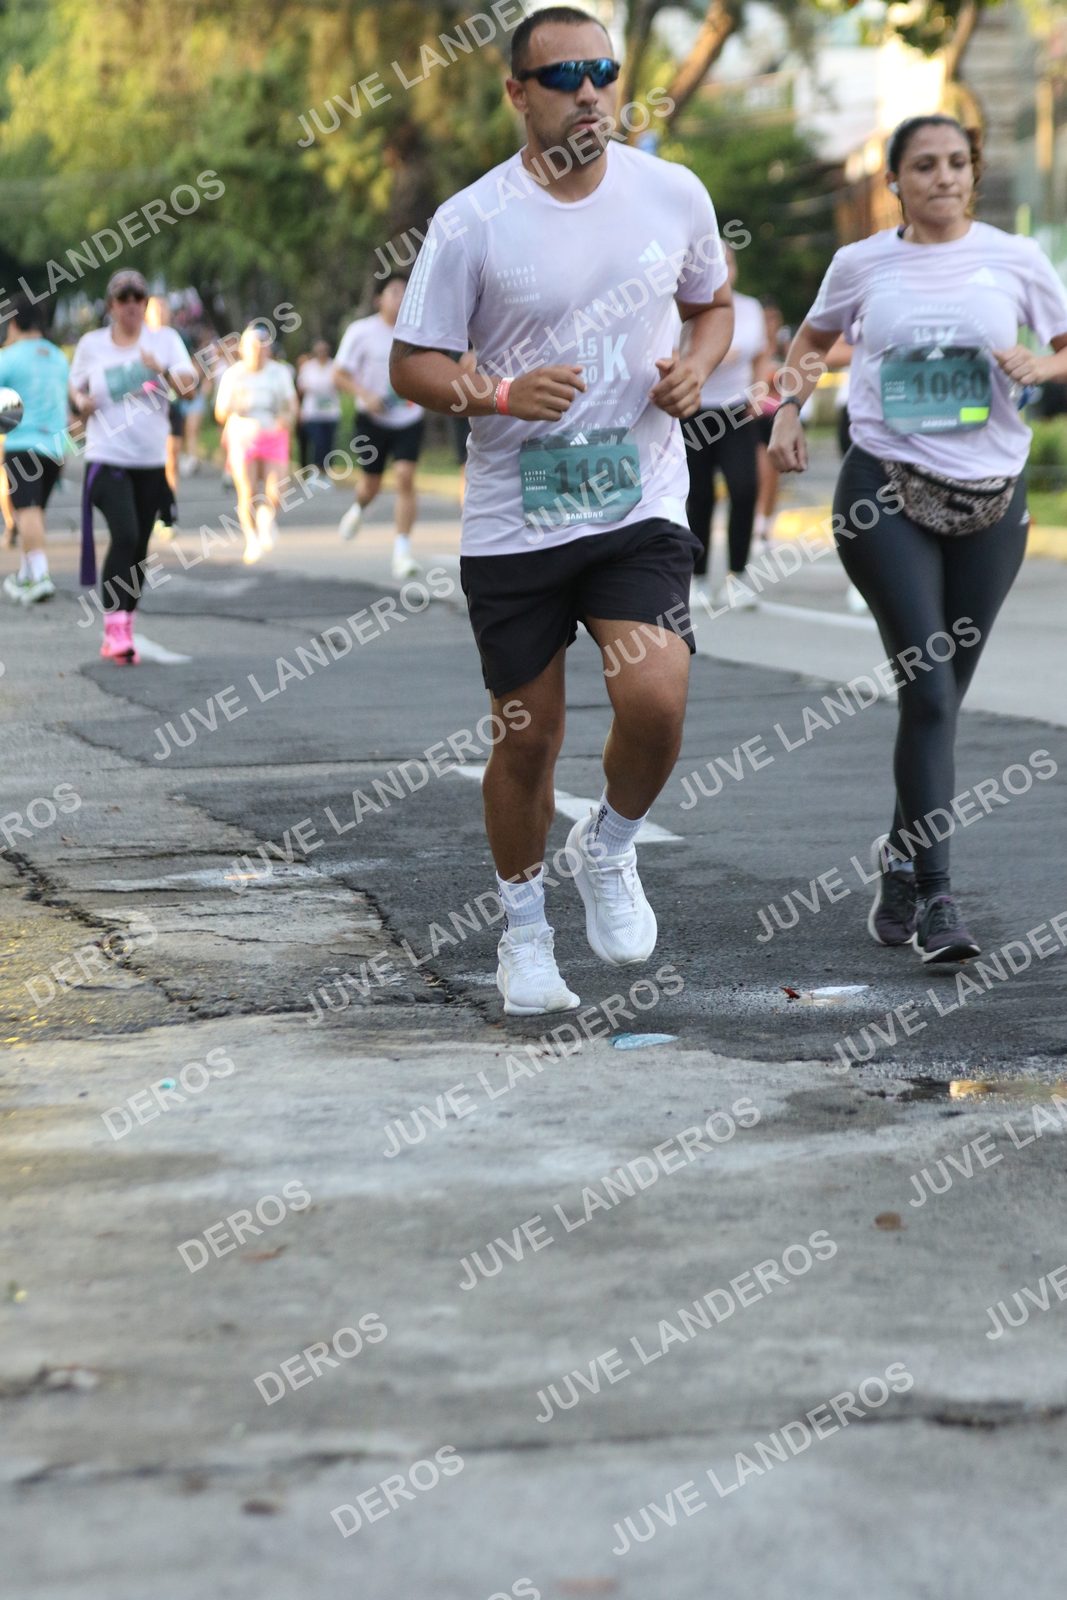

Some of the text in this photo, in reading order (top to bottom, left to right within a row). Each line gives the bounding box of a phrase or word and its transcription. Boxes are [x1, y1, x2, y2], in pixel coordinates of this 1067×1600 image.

[577, 336, 598, 358] 15
[603, 333, 631, 383] K
[912, 368, 988, 405] 1060
